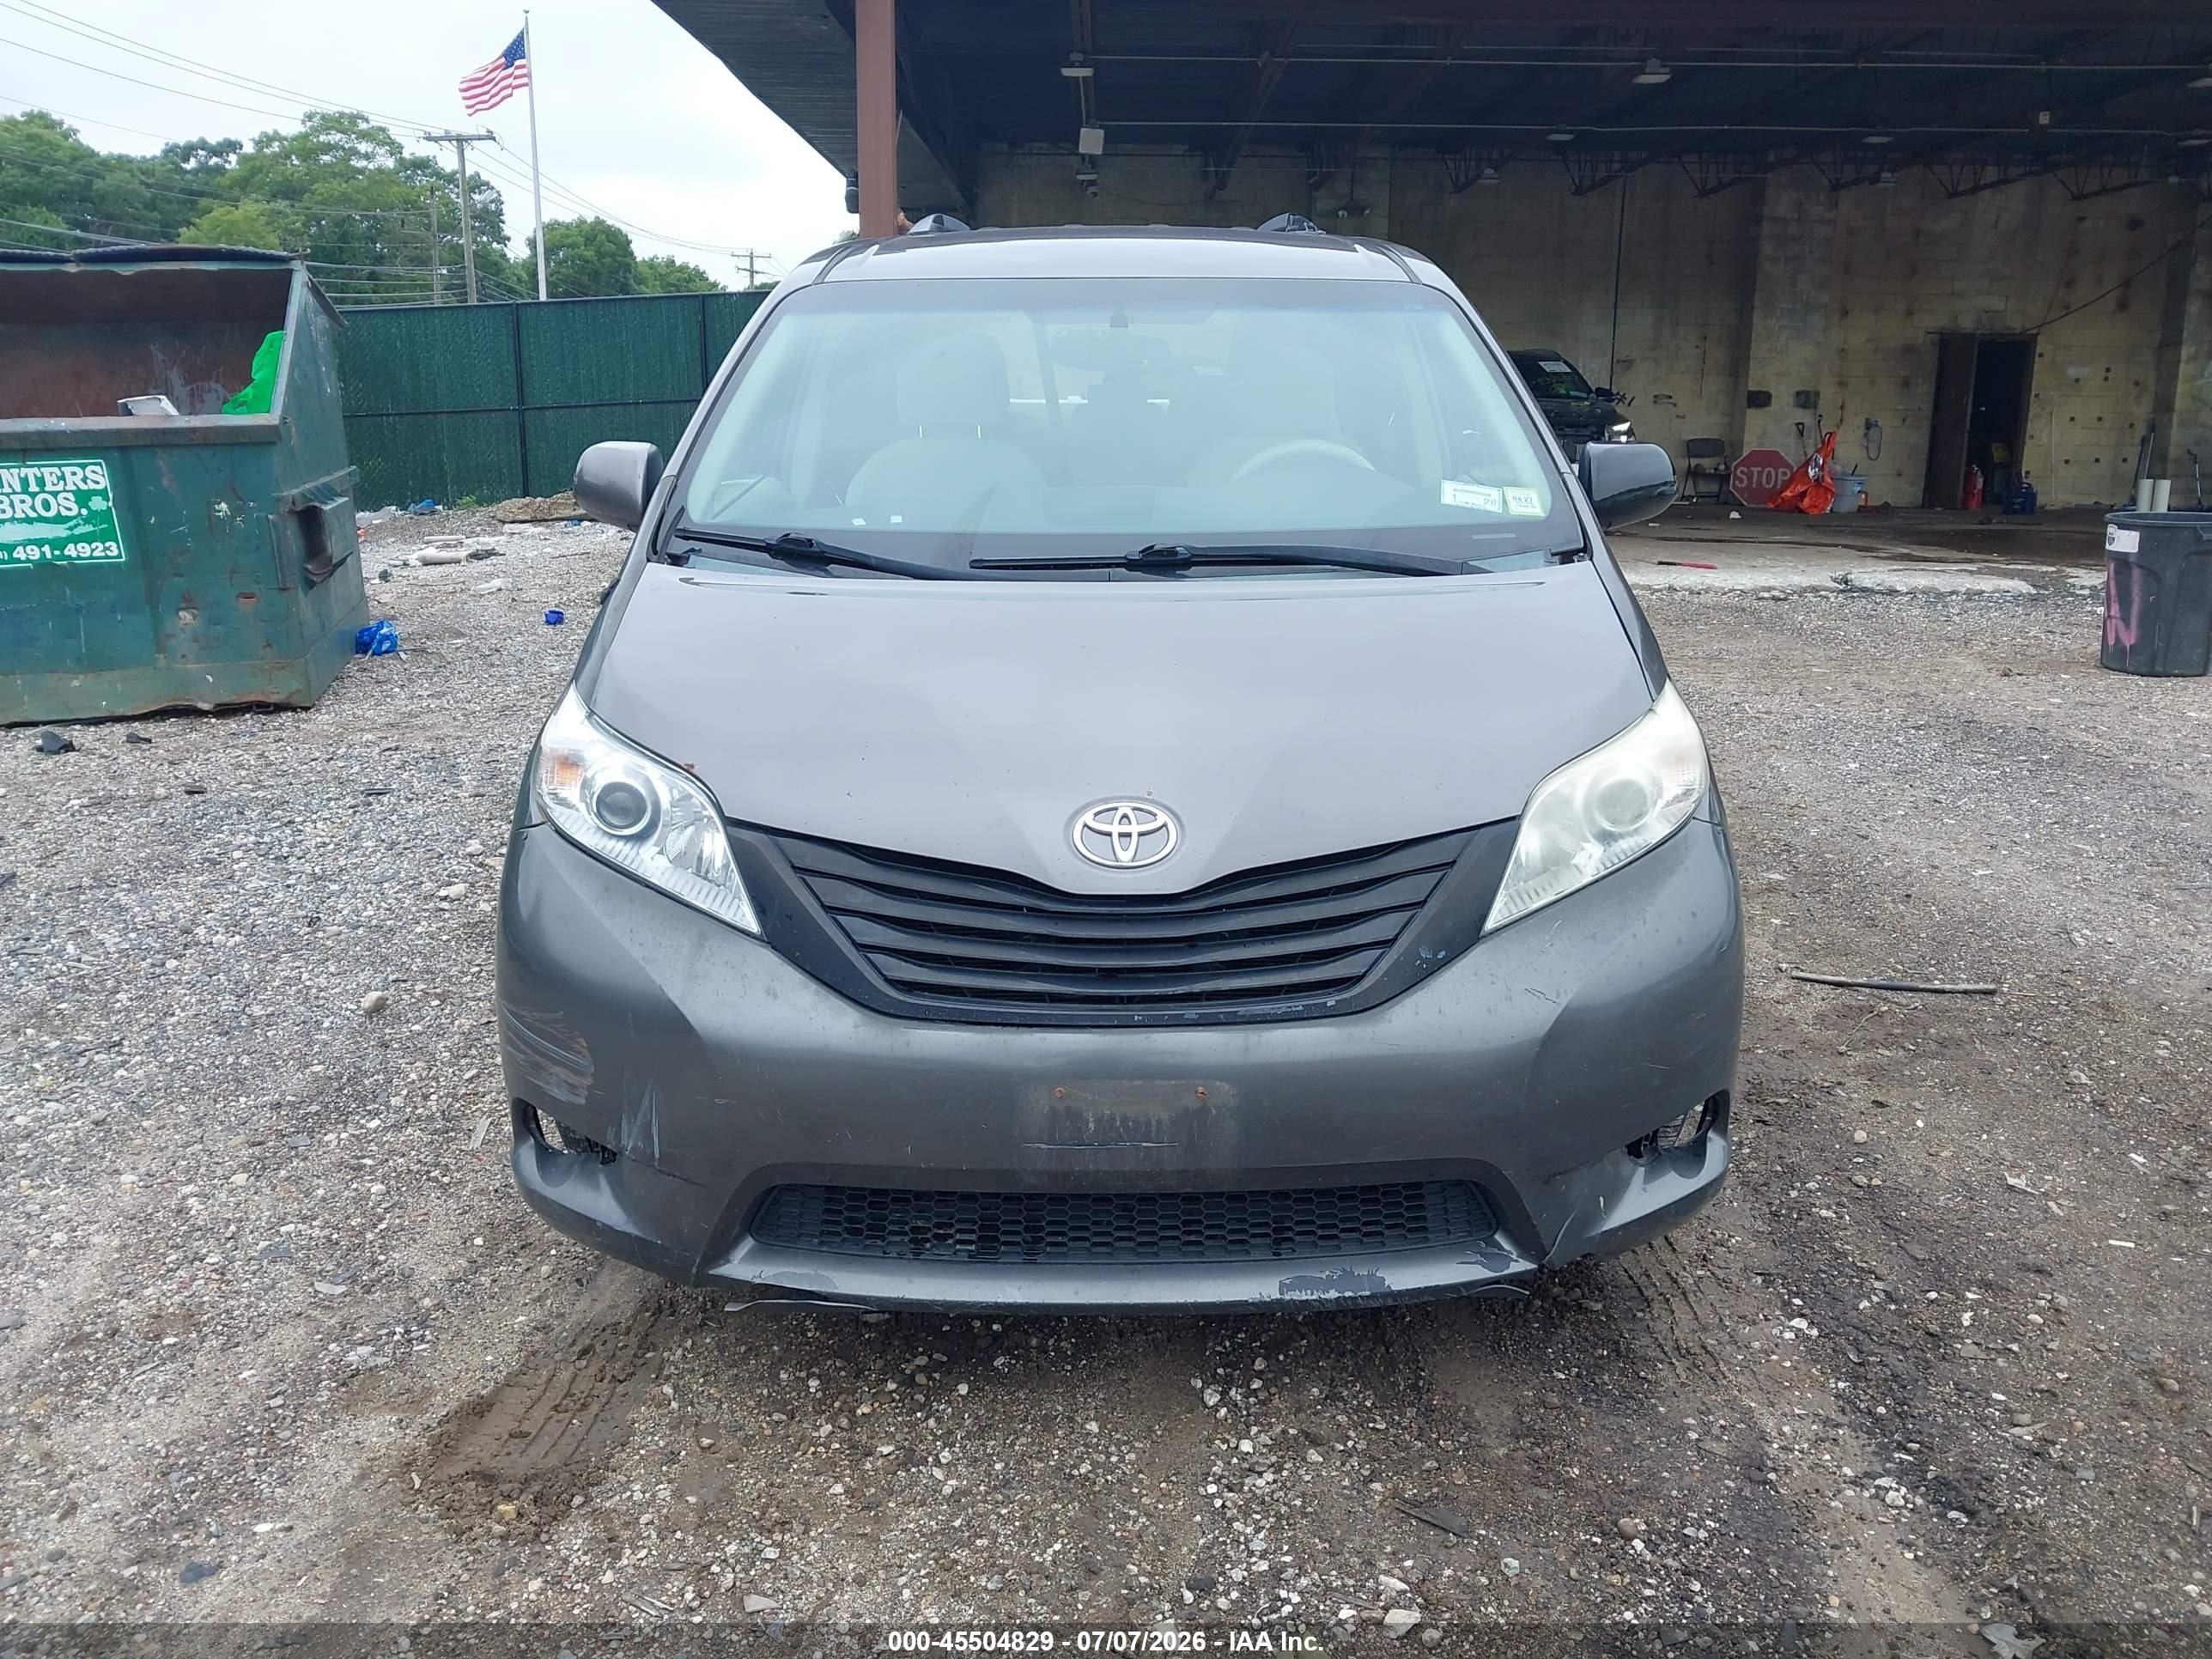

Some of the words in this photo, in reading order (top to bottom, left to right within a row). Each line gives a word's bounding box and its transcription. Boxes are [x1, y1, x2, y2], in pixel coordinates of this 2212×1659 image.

[0, 465, 106, 493] NTERS
[1735, 466, 1791, 489] STOP
[13, 541, 118, 560] 491-4923
